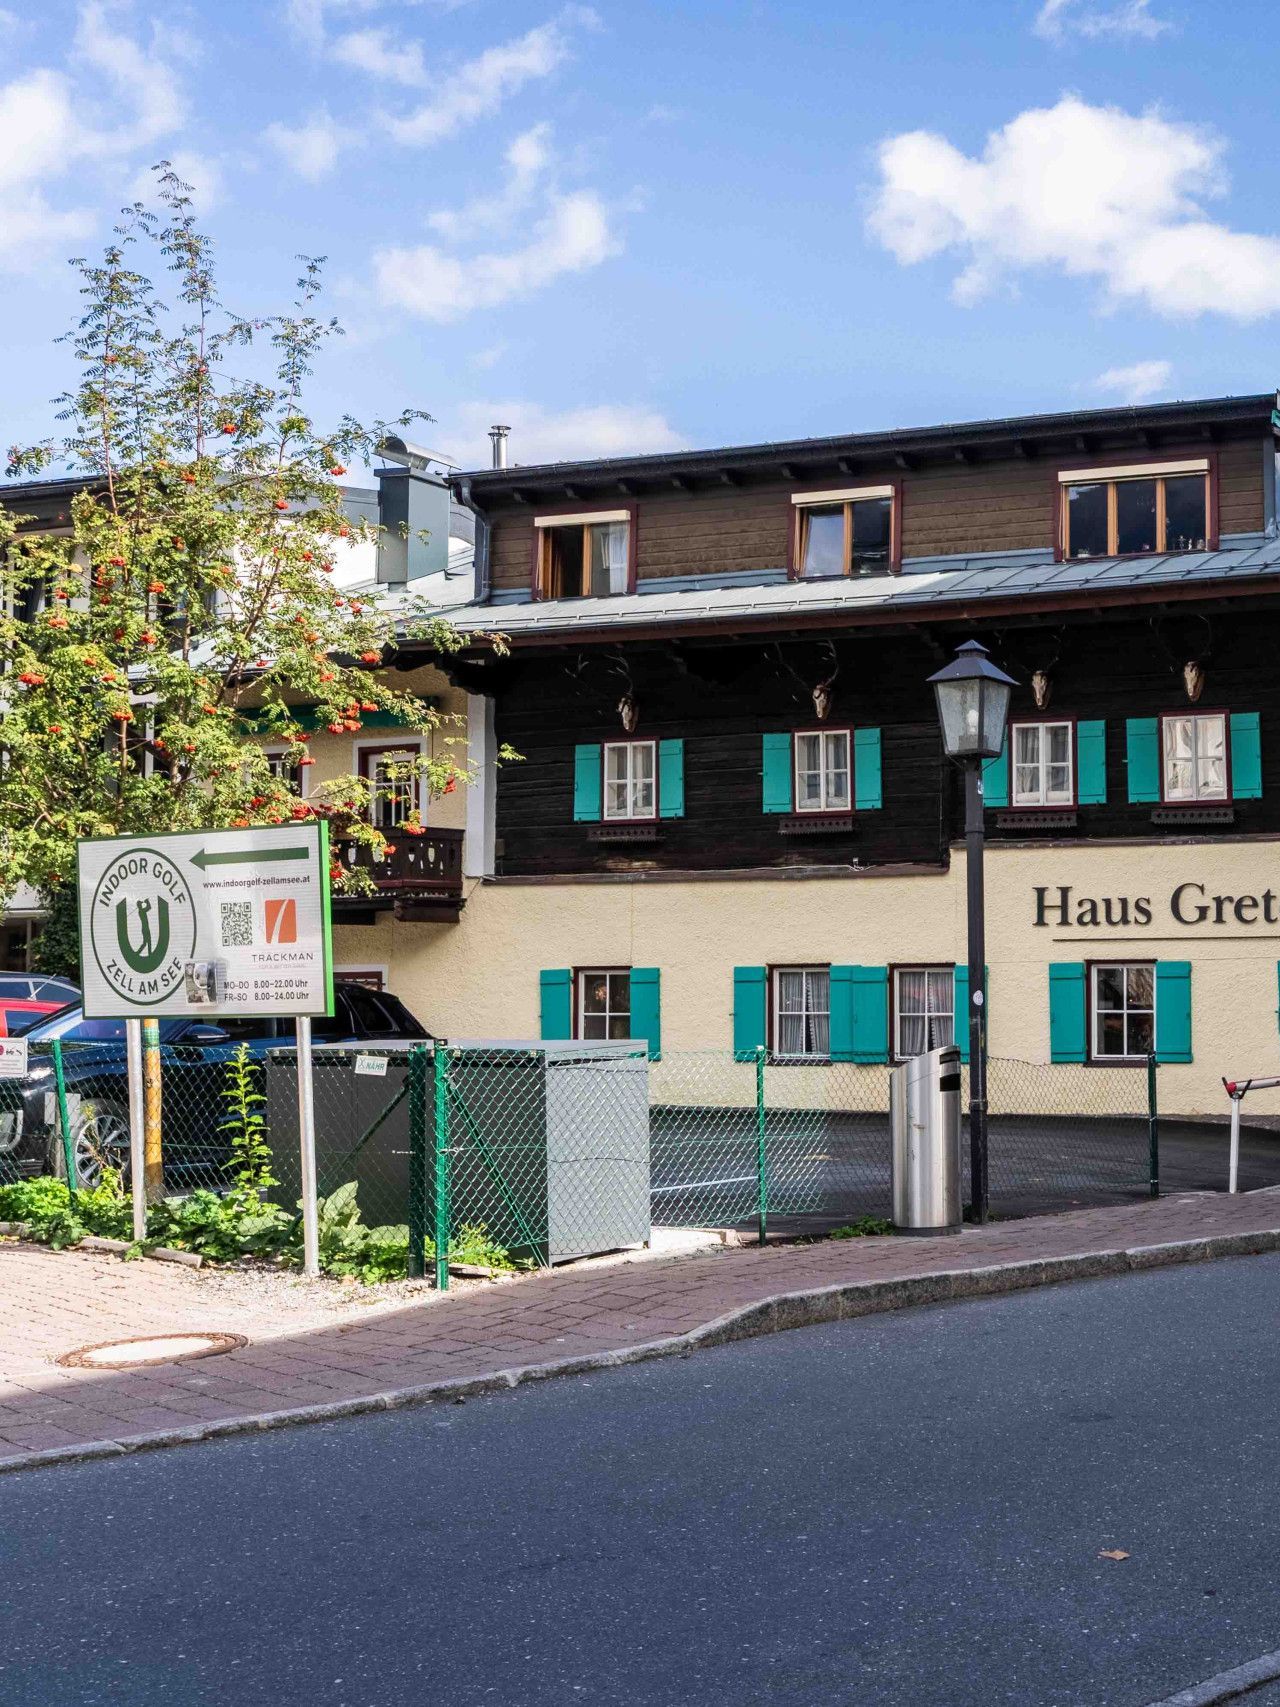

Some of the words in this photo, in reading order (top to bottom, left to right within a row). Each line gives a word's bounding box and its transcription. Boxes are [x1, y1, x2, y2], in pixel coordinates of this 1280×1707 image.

[98, 857, 148, 907] INDOOR
[153, 861, 187, 906] GOLF
[203, 875, 310, 889] www.indoorgolf-zellamsee.at
[1032, 886, 1152, 927] Haus
[252, 952, 314, 963] TRACKMAN
[107, 958, 134, 993] ZELL
[138, 977, 158, 996] AM
[162, 956, 184, 989] SEE
[224, 980, 250, 989] MO-DO
[295, 979, 308, 988] Uhr
[224, 992, 248, 1001] FR-SO
[296, 991, 310, 1000] Uhr
